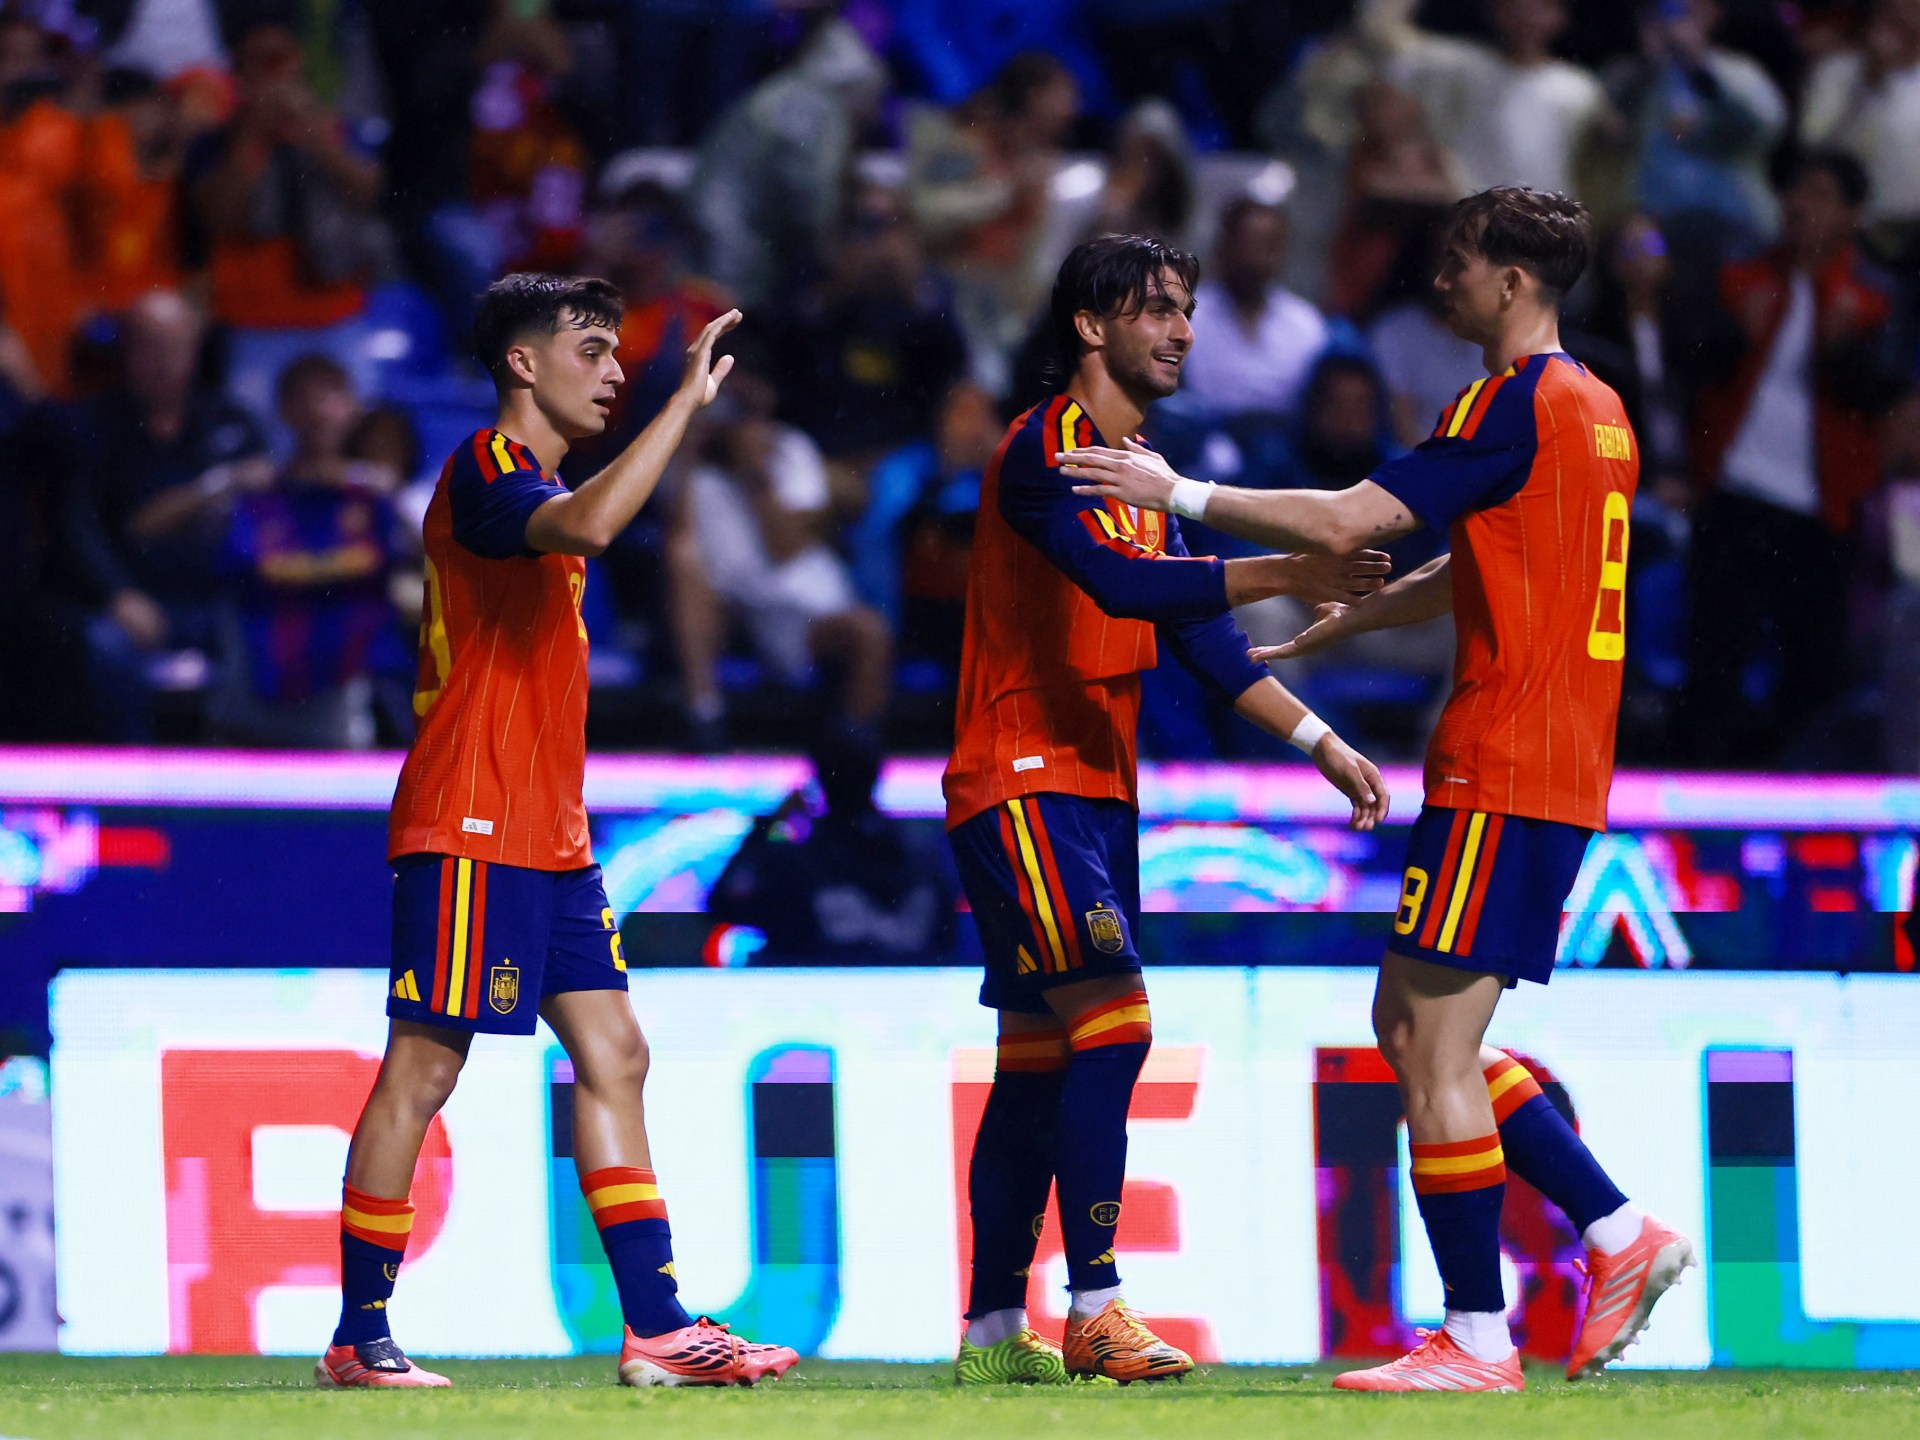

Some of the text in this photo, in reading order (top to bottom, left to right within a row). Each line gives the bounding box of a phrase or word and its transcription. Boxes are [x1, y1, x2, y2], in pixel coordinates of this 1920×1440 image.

[1593, 419, 1631, 461] FABIÁN
[1587, 491, 1630, 661] 8
[1395, 866, 1428, 935] 8
